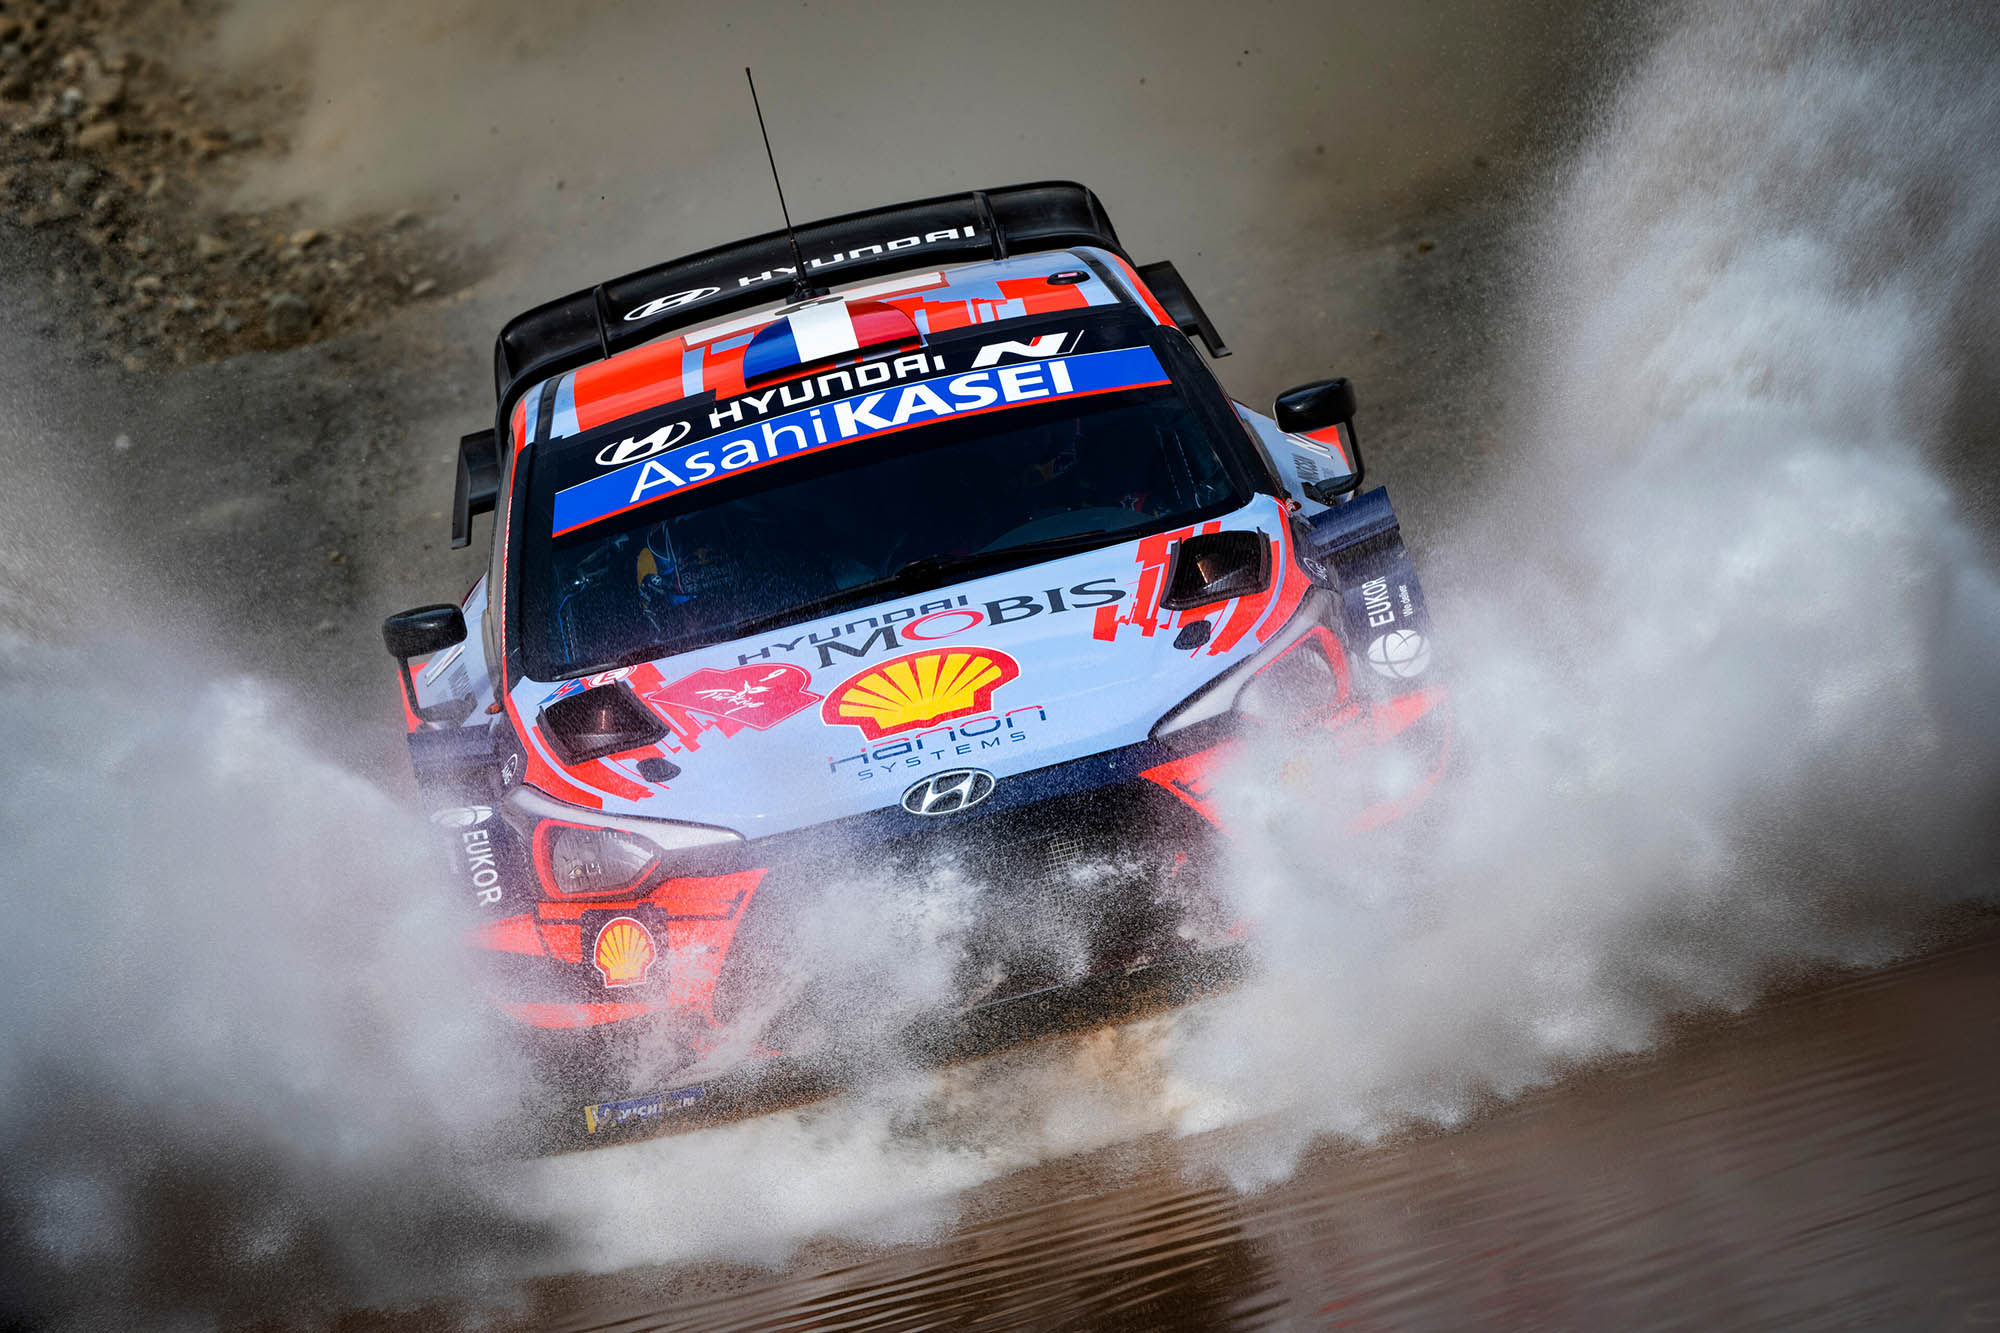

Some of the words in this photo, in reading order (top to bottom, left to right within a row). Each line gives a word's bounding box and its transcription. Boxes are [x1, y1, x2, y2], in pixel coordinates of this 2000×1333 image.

[738, 225, 976, 287] HYUNDAI
[708, 352, 946, 429] HYUNDAI
[736, 594, 970, 666] HYUNDAI
[816, 578, 1127, 669] MOBIS
[1361, 575, 1395, 628] EUKOR
[857, 730, 1027, 782] SYSTEMS
[462, 829, 502, 907] EUKOR
